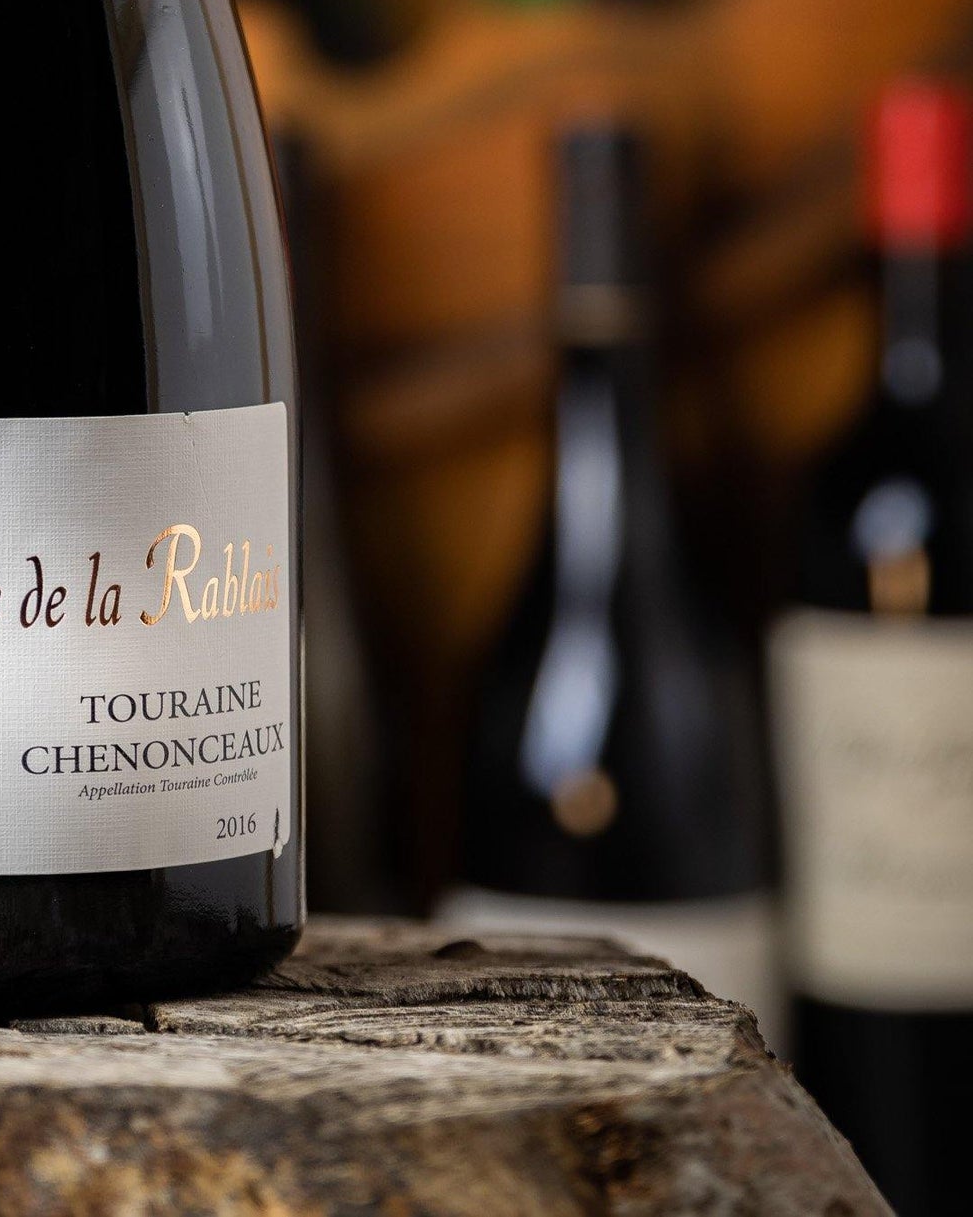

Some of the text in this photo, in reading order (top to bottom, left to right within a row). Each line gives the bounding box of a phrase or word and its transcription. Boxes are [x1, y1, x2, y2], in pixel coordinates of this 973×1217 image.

[20, 555, 67, 628] de
[85, 551, 122, 627] la
[139, 524, 280, 626] Rablais
[80, 680, 262, 724] TOURAINE
[21, 722, 284, 774] CHENONCEAUX
[78, 768, 258, 801] Appellation Touraine Contrôlée
[216, 812, 257, 840] 2016
